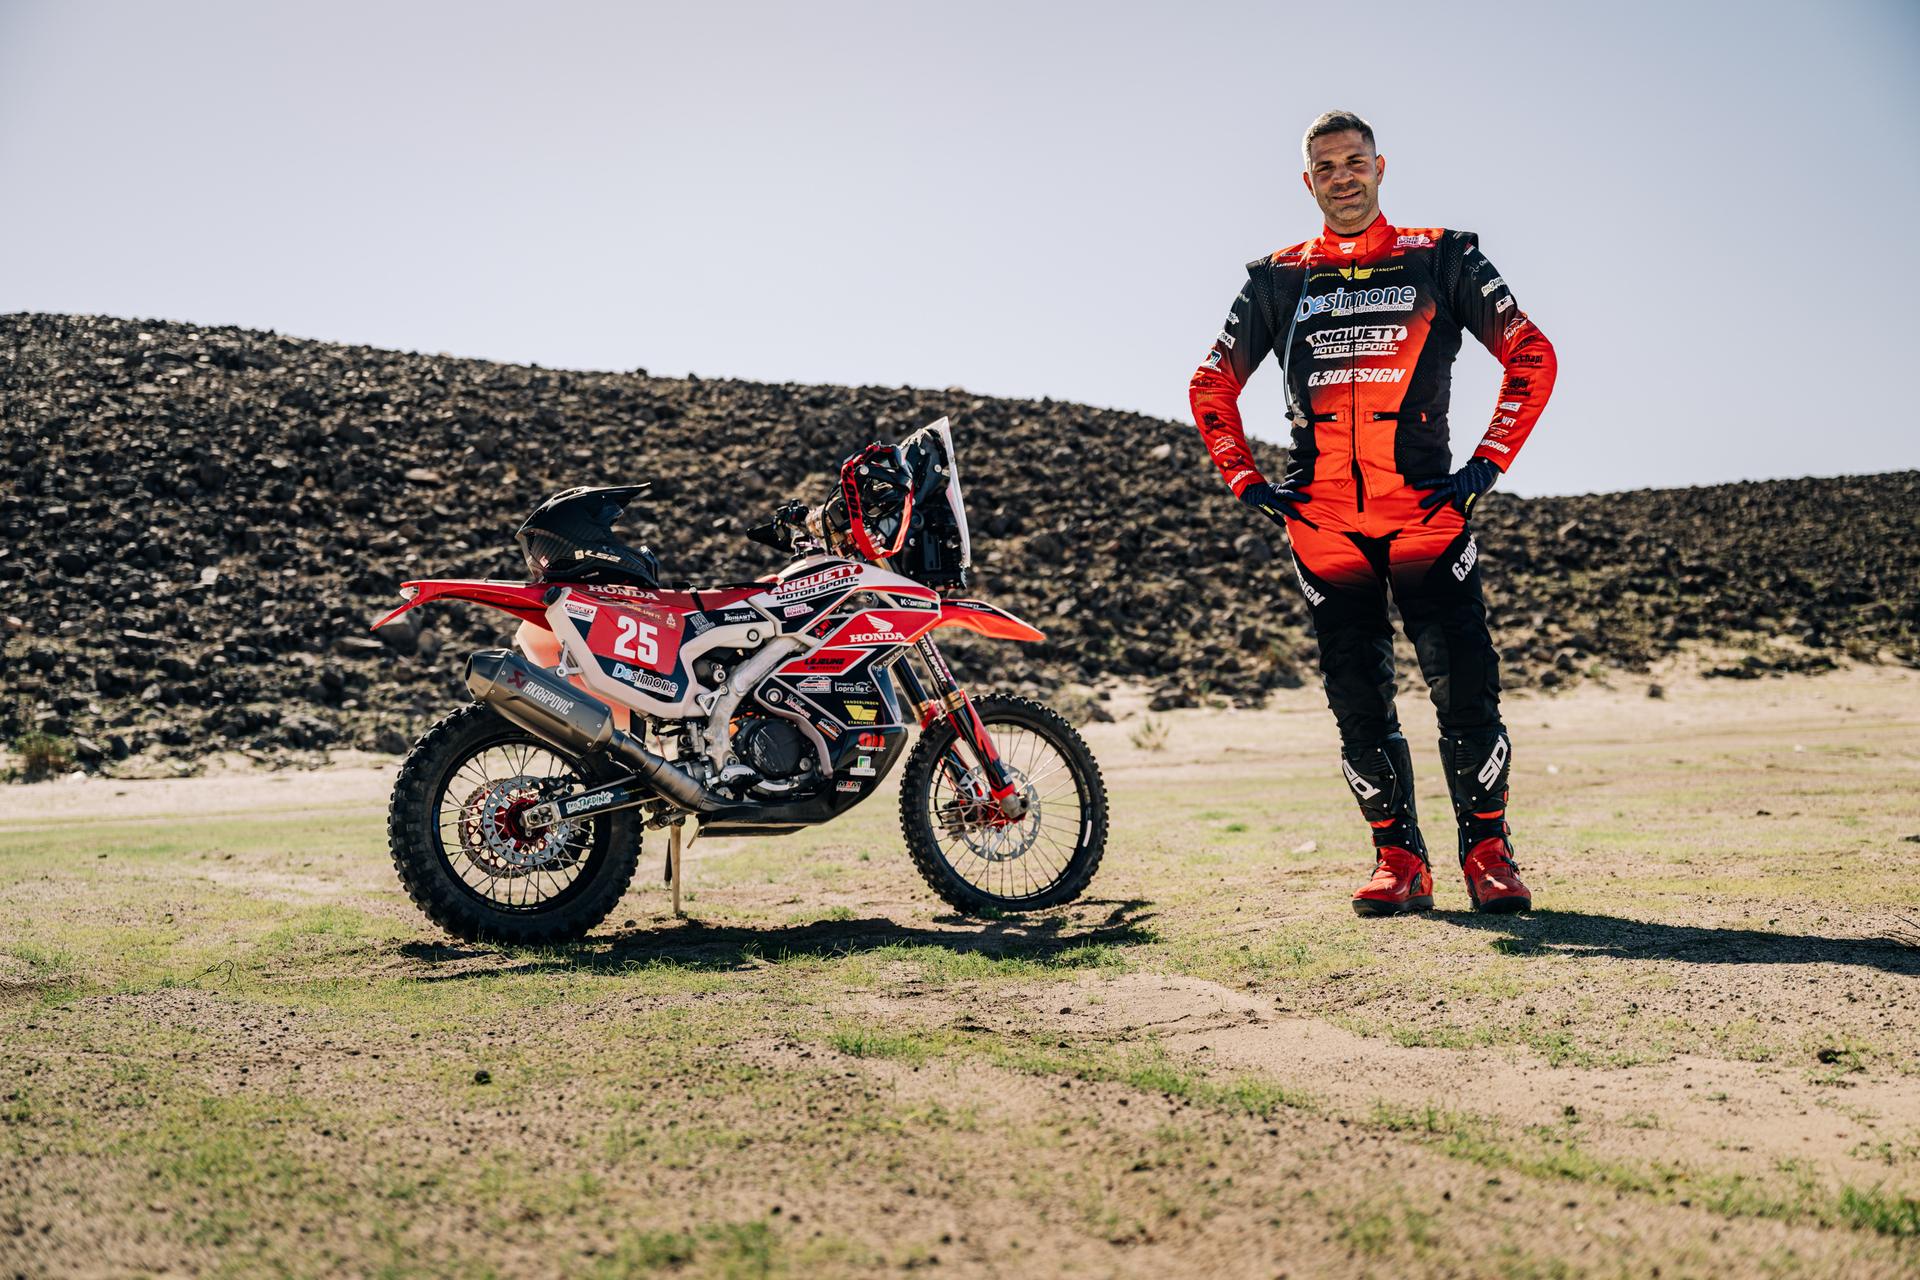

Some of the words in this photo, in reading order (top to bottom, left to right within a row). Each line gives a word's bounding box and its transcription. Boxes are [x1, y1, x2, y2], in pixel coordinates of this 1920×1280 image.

[1297, 286, 1416, 322] Desimone
[1311, 326, 1404, 345] ANQUETY
[1312, 344, 1350, 355] MOTOR
[1354, 342, 1396, 351] SPORT
[1307, 367, 1407, 387] 6.3DESIGN
[770, 564, 860, 594] ANQUETY
[776, 588, 816, 601] MOTOR
[818, 576, 856, 590] SPORT
[587, 584, 660, 601] HONDA
[613, 615, 659, 665] 25
[849, 632, 906, 643] HONDA
[612, 663, 679, 693] Desimone
[523, 681, 575, 715] AKRAPOVIČ
